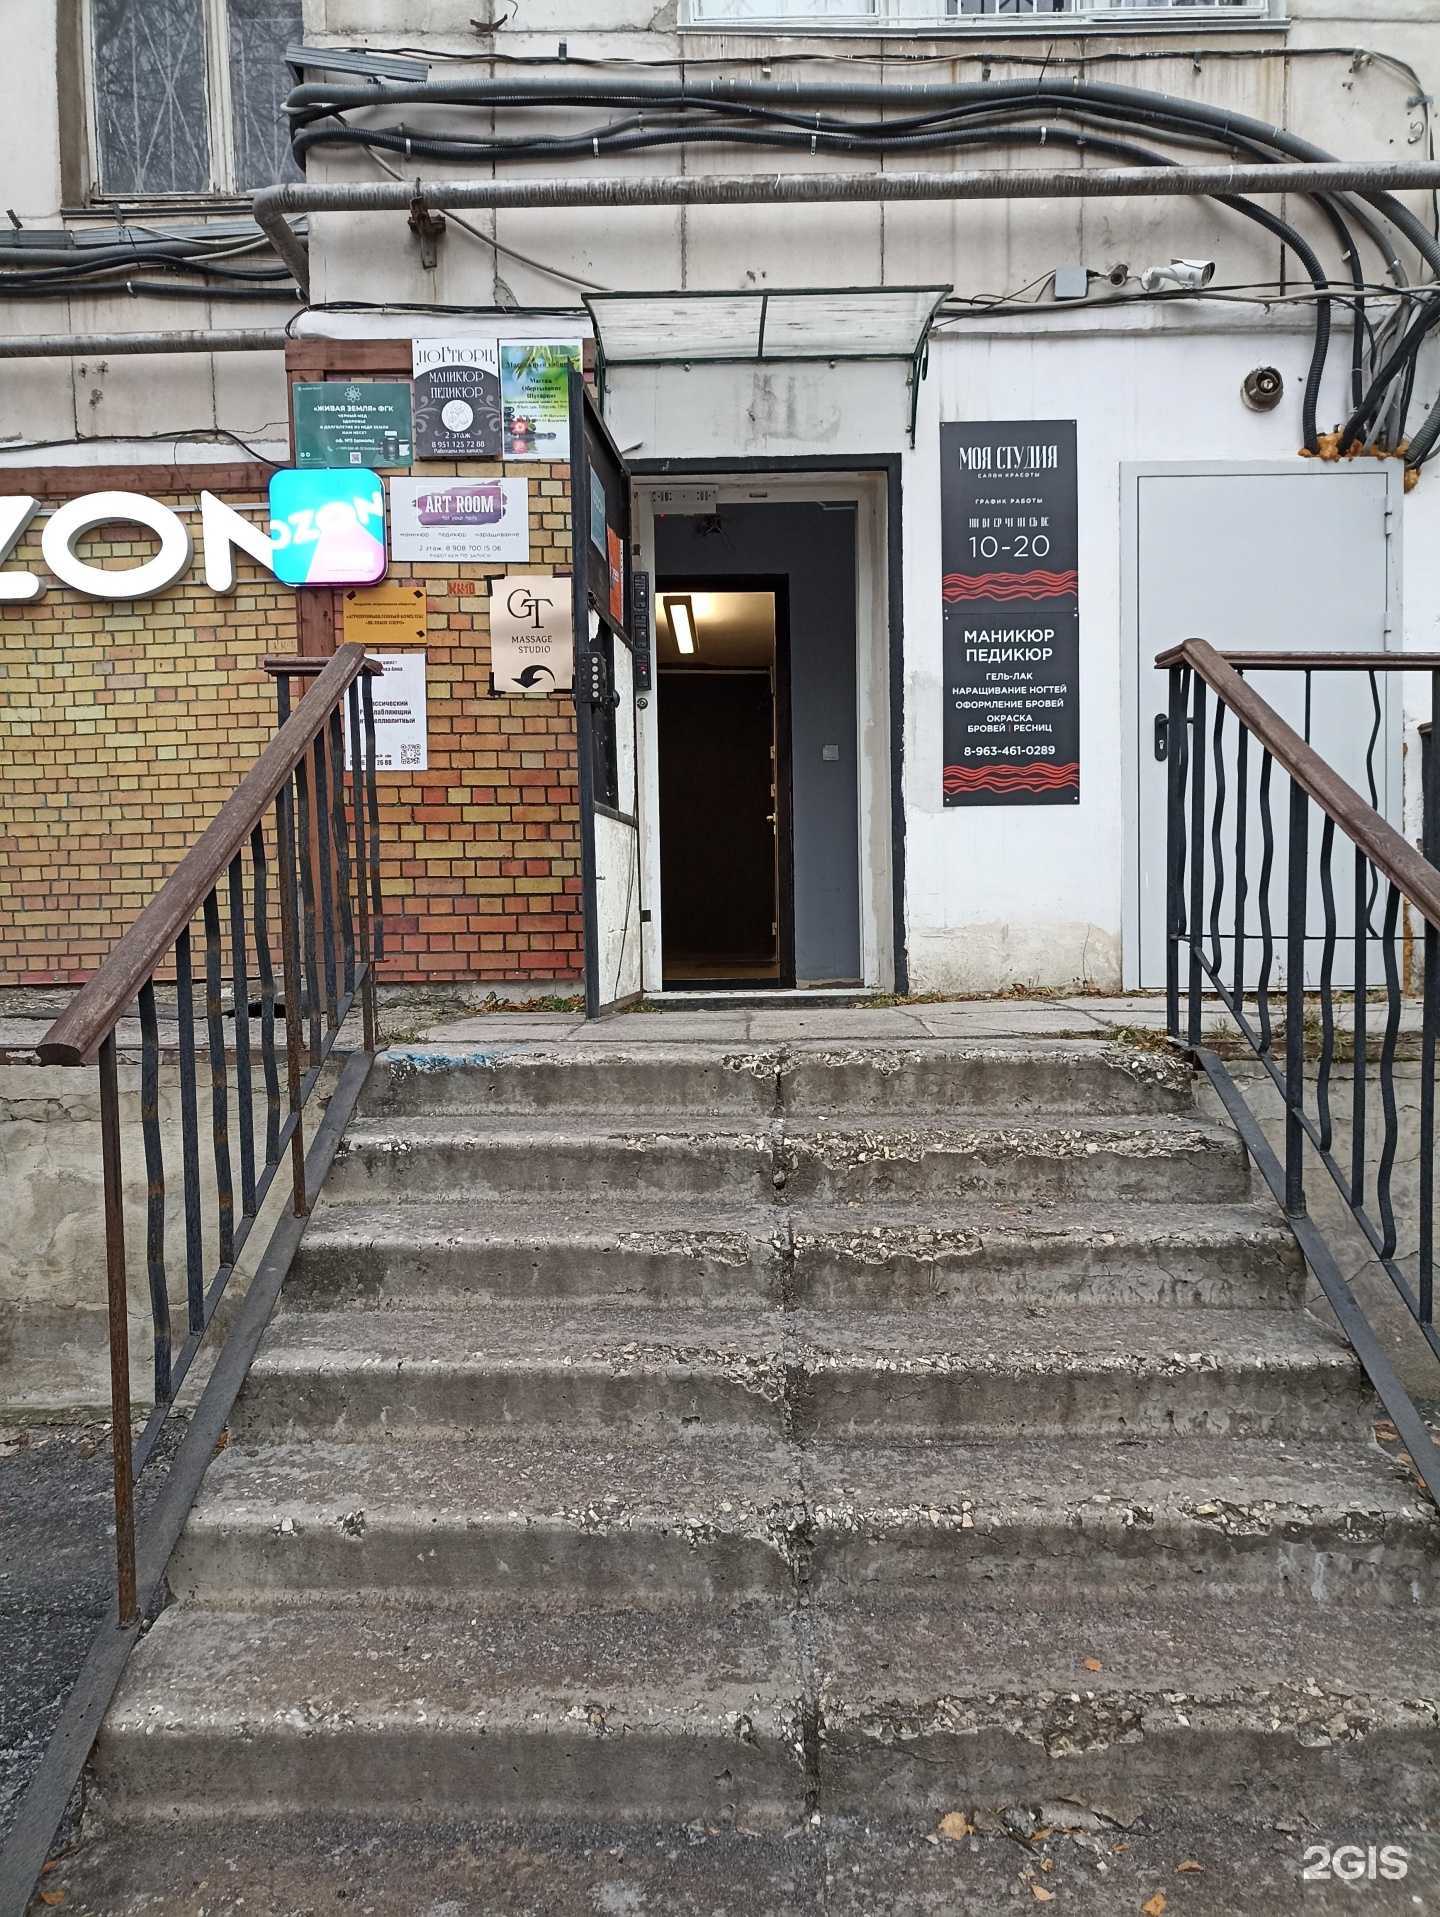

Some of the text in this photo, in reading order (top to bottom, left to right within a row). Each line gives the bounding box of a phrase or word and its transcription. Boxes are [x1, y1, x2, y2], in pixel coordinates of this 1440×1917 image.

[430, 371, 484, 383] МАНИКЮР
[431, 386, 484, 398] ПЕДИКЮР
[960, 445, 1058, 470] МОЯ СТУДИЯ
[425, 496, 494, 513] ART ROOM
[968, 534, 1050, 558] 10-20
[507, 588, 554, 628] GT
[512, 636, 552, 644] MASSAGE
[964, 629, 1054, 643] МАНИКЮР
[518, 646, 550, 654] STUDIO
[966, 648, 1053, 664] ПЕДИКЮР
[986, 672, 1033, 680] ГЕЛЬ-ЛАК
[952, 684, 1068, 696] НАРАЩИВАНИЕ НОГТЕЙ
[955, 698, 1064, 709] ОФОРМЛЕНИЕ БРОВЕЙ
[986, 714, 1032, 722] ОКРАСКА
[968, 723, 1052, 732] БРОВЕЙ РЕСНИЦ
[964, 746, 1056, 756] 8-963-461-0289
